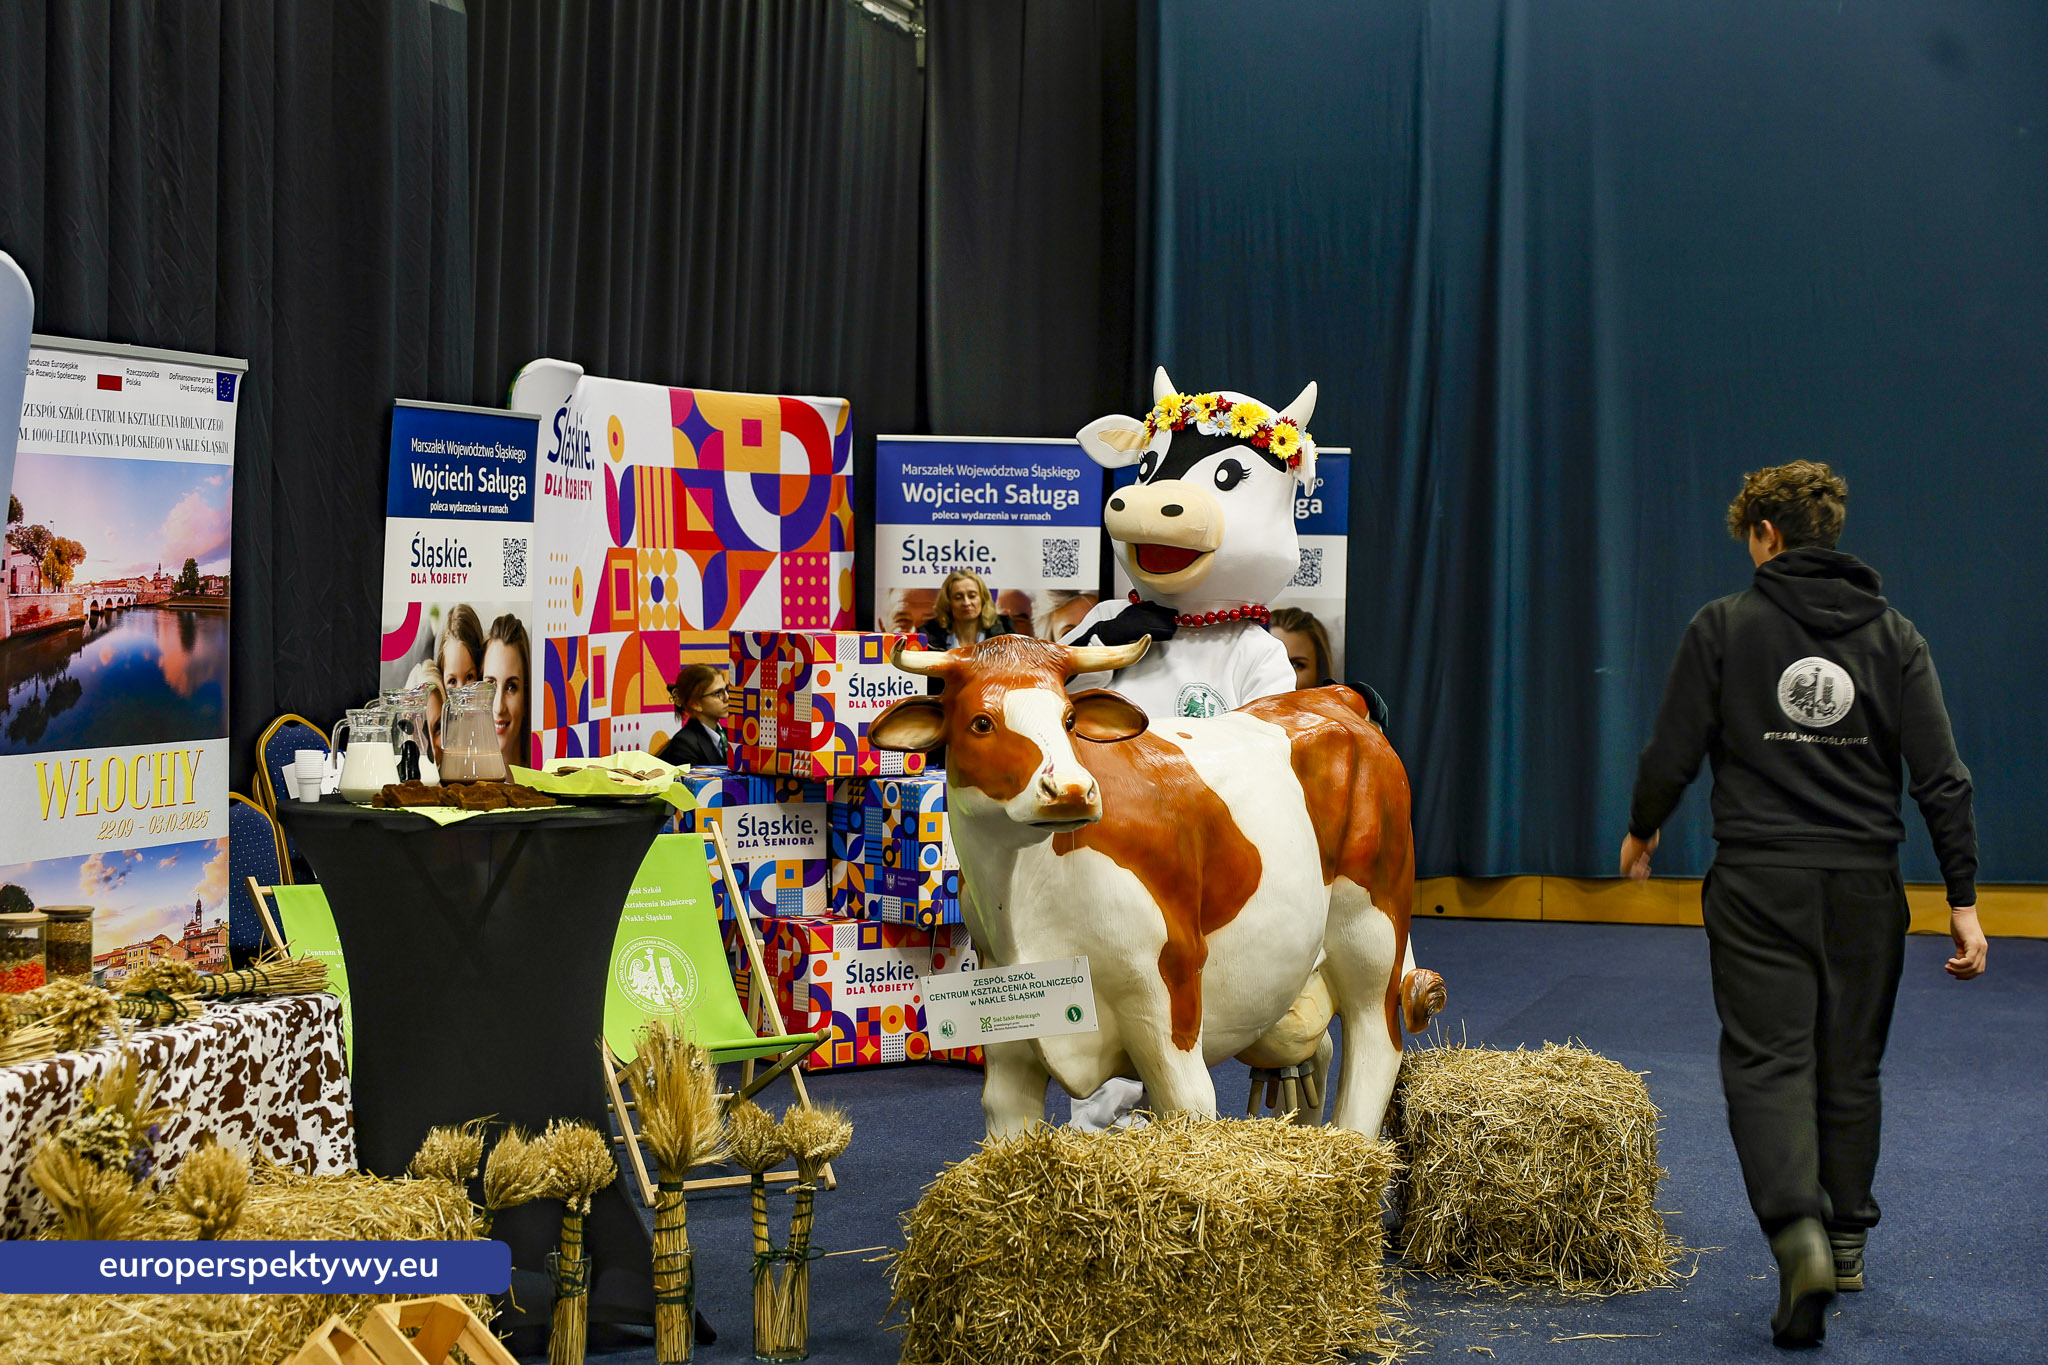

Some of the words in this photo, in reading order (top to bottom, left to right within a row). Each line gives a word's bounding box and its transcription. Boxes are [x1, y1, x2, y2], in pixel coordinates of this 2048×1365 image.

[28, 358, 50, 368] undusze
[51, 360, 78, 370] Europejskie
[36, 369, 56, 379] Rozwoju
[57, 371, 86, 382] Społecznego
[126, 368, 160, 378] Rzeczpospolita
[169, 372, 201, 383] Dofinansowane
[126, 378, 141, 386] Polska
[180, 384, 190, 392] Unię
[190, 385, 214, 394] Europejską
[23, 402, 58, 418] ZESPÓŁ
[59, 404, 84, 420] SZKÓŁ
[86, 408, 126, 424] CENTRUM
[128, 412, 179, 428] KSZTAŁCENIA
[180, 416, 224, 432] ROLNICZEGO
[19, 427, 30, 441] M.
[32, 428, 79, 444] 1000-LECIA
[80, 429, 120, 446] PAŃSTWA
[122, 434, 165, 450] POLSKIEGO
[166, 438, 173, 450] W
[175, 438, 200, 452] NAKLE
[411, 438, 446, 454] Marszałek
[446, 440, 494, 458] Województwa
[495, 442, 527, 464] Śląskiego
[902, 464, 954, 476] Marszałek
[956, 464, 1029, 479] Województwa
[1031, 464, 1080, 480] Śląskiego
[411, 462, 474, 497] Wojciech
[478, 467, 527, 502] Saługa
[544, 473, 562, 498] DLA
[565, 478, 592, 500] KOBIETY
[902, 482, 998, 508] Wojciech
[1005, 484, 1080, 510] Saługa
[430, 500, 448, 514] poleca
[450, 502, 481, 514] wydarzenia
[482, 505, 488, 513] w
[488, 503, 509, 514] ramach
[932, 511, 959, 521] poleca
[961, 511, 1009, 521] wydarzenia
[1020, 512, 1051, 520] ramach
[411, 532, 472, 574] Śląskie.
[902, 534, 997, 568] Śląskie.
[902, 566, 926, 574] DLA
[411, 573, 427, 584] DLA
[431, 573, 468, 584] KOBIETY
[848, 673, 918, 702] Śląskie.
[849, 700, 867, 708] DLA
[34, 748, 204, 820] WŁOCHY
[97, 818, 134, 840] 22.09
[148, 809, 211, 835] 03.10.2025
[737, 812, 819, 840] Śląskie.
[738, 839, 759, 849] DLA
[764, 837, 815, 846] SENIORA
[660, 898, 696, 907] Rolniczego
[624, 914, 644, 922] Nakle
[646, 913, 673, 922] Śląskim
[846, 960, 919, 987] Śląskie.
[973, 976, 1006, 987] ZESPÓŁ
[1008, 972, 1036, 982] SZKÓŁ
[846, 987, 865, 996] DLA
[870, 983, 915, 993] KOBIETY
[929, 990, 969, 1002] CENTRUM
[971, 984, 1028, 997] KSZTAŁCENIA
[1029, 976, 1084, 989] ROLNICZEGO
[978, 995, 1007, 1005] NAKLE
[1008, 990, 1046, 1002] ŚLĄSKIM
